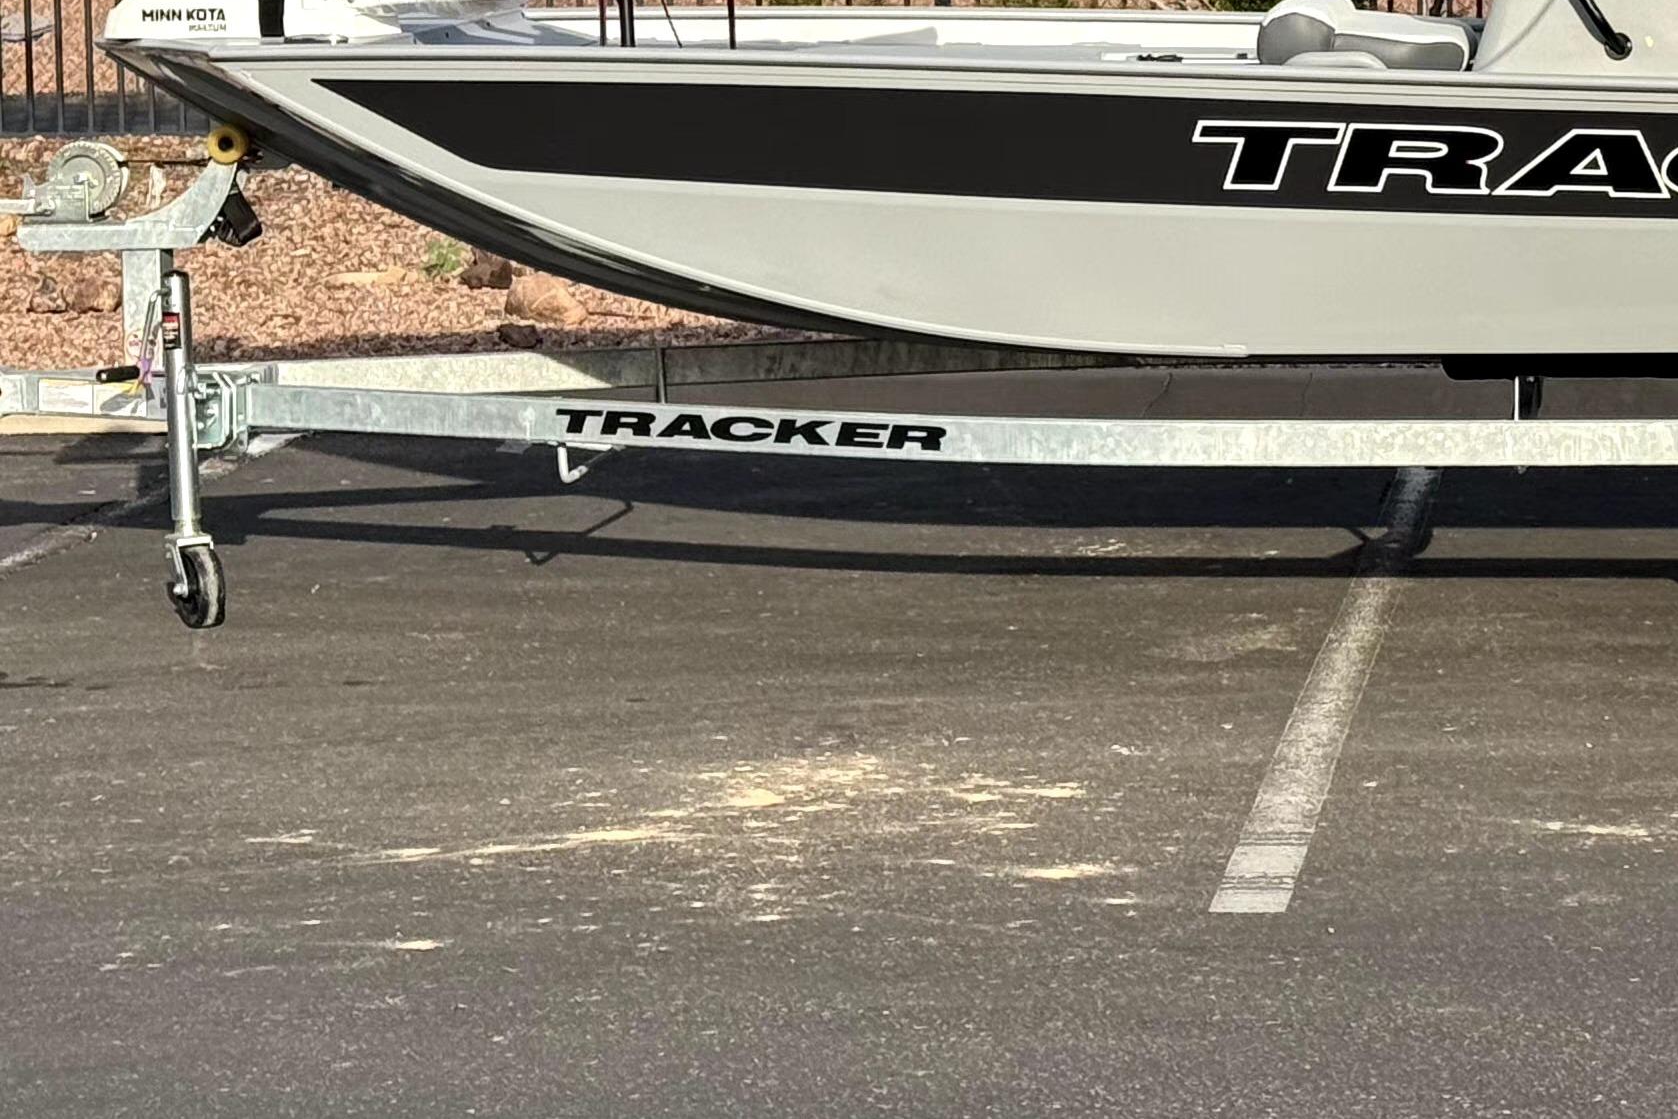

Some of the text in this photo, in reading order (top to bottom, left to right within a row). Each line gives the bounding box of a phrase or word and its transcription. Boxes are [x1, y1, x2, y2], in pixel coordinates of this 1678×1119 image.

[142, 8, 226, 22] MINN KOTA
[556, 409, 946, 451] TRACKER
